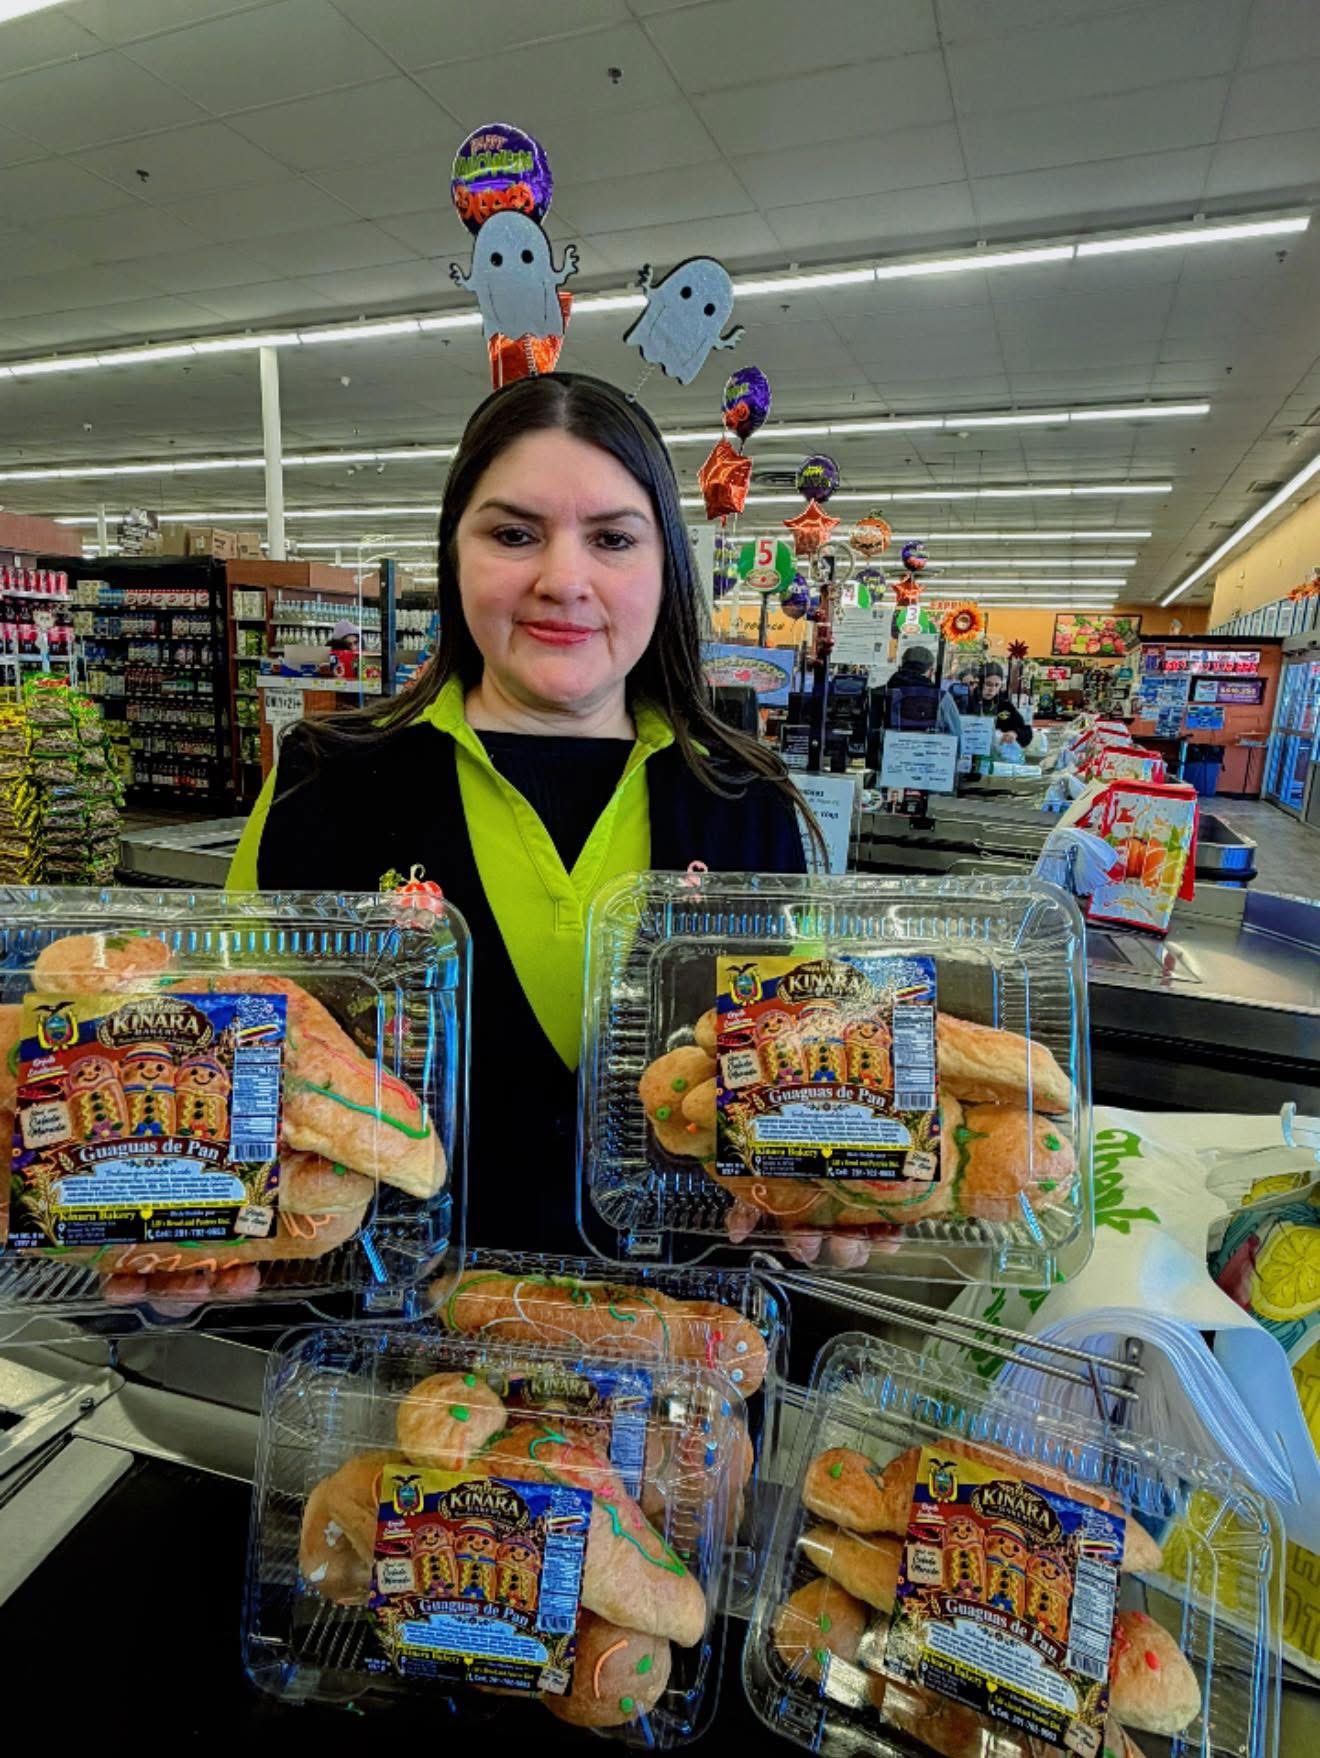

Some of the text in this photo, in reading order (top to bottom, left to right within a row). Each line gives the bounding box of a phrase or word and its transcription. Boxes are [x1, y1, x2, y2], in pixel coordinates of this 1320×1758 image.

[758, 539, 773, 566] 5
[789, 973, 861, 996] KINARA
[111, 1013, 199, 1036] KINARA
[768, 1086, 886, 1108] Guaguas de Pan
[79, 1138, 220, 1162] Guaguas de Pan
[532, 1376, 590, 1399] KINARA
[450, 1492, 520, 1518] KINARA
[982, 1488, 1050, 1530] KINARA
[419, 1599, 530, 1626] Guaguas de Pan
[945, 1599, 1058, 1659] Guaguas de Pan
